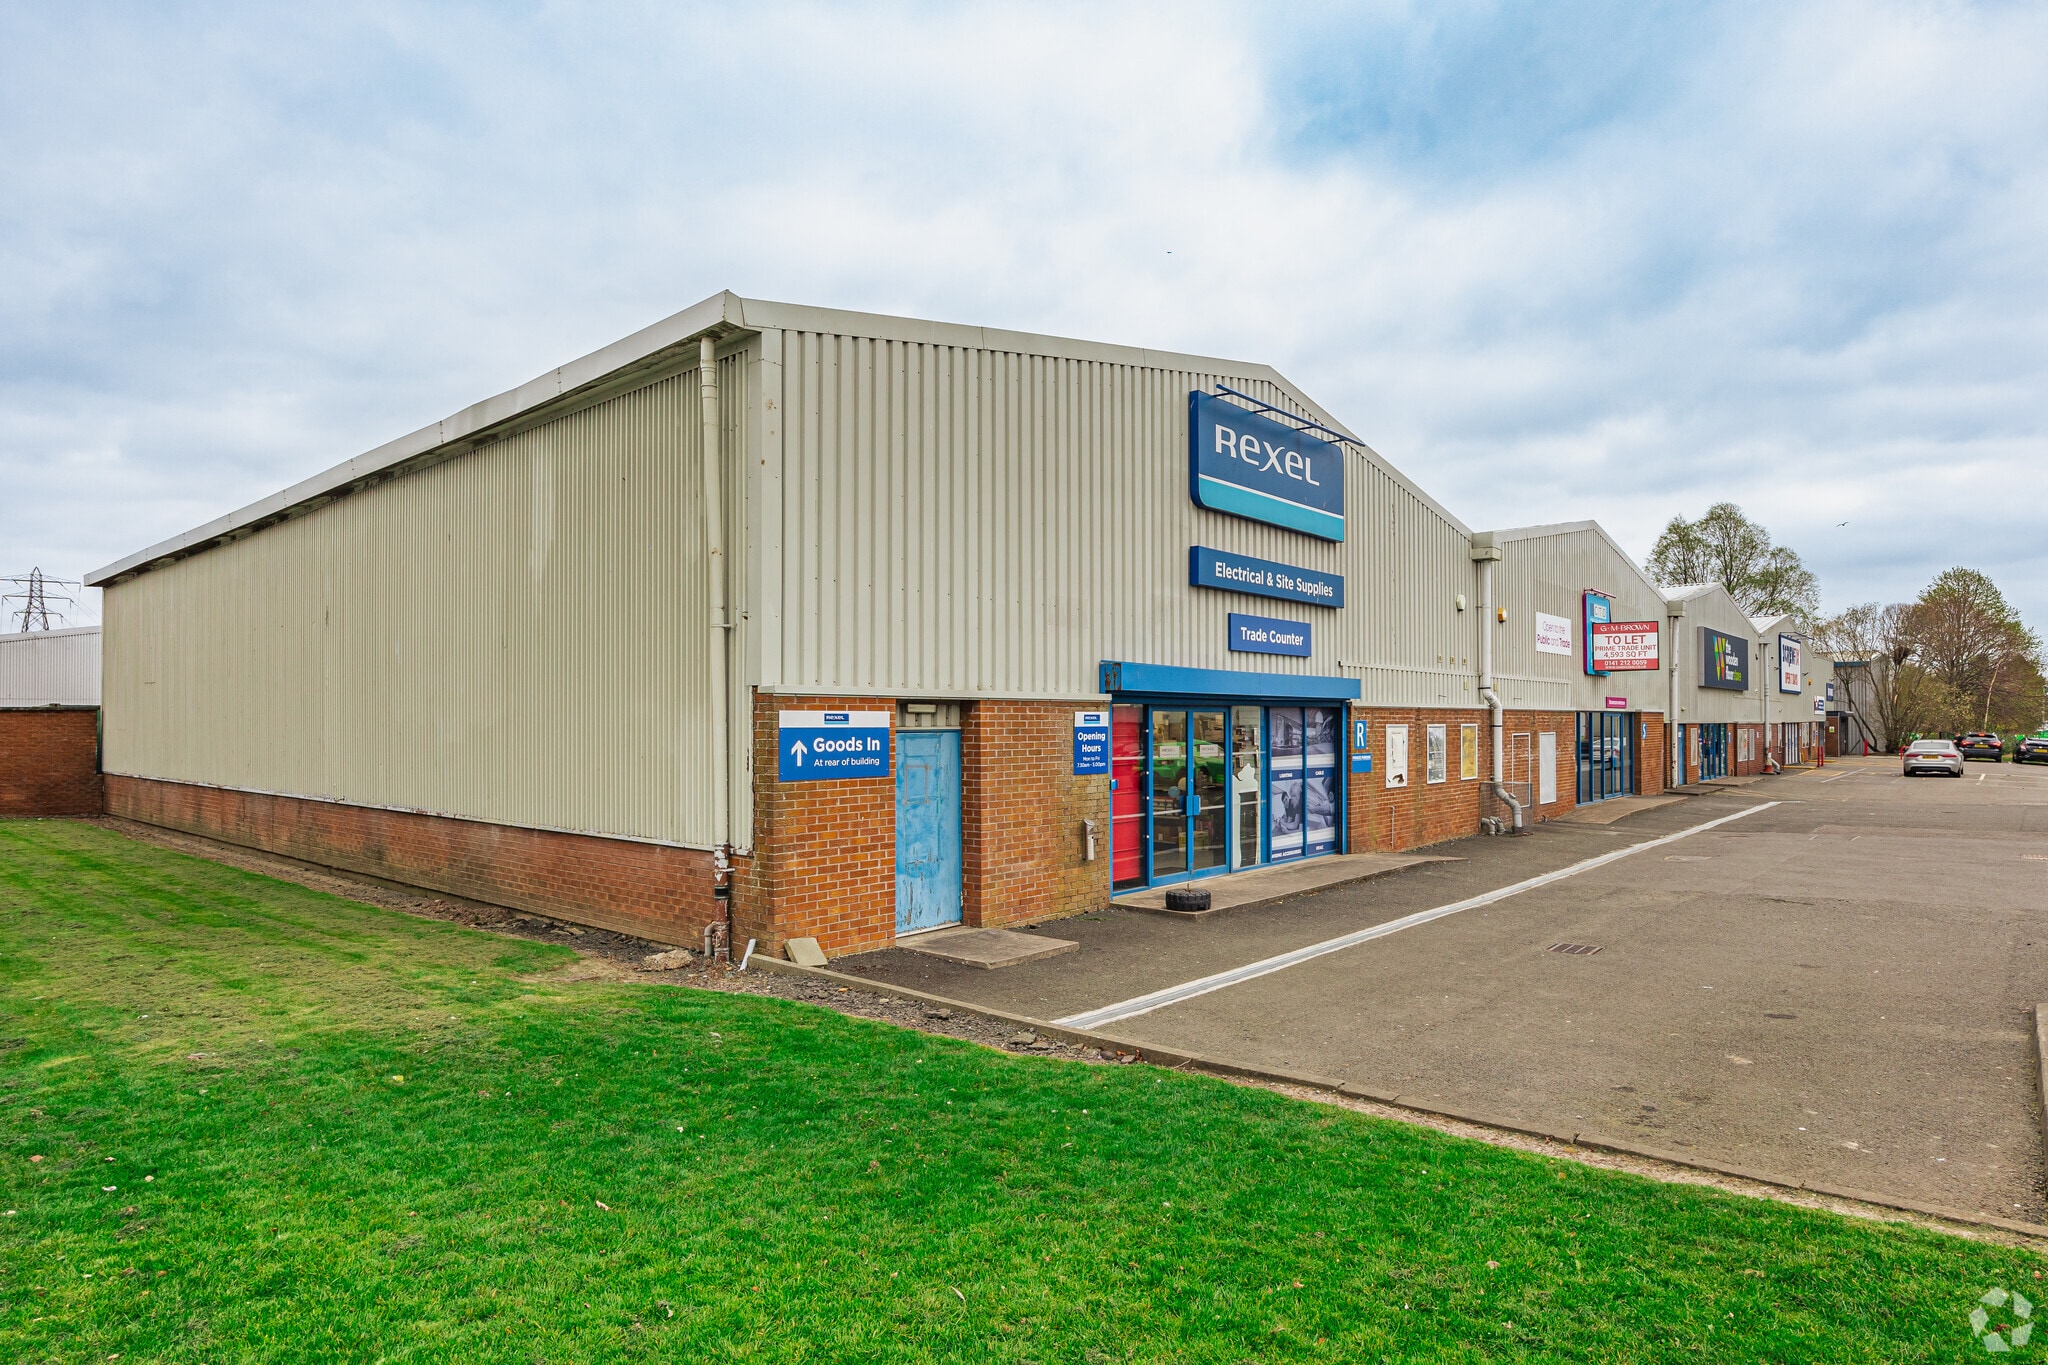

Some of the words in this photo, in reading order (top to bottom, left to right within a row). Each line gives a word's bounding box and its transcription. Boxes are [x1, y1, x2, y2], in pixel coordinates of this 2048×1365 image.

[1215, 561, 1264, 585] Electrical
[1266, 572, 1274, 587] &
[1276, 574, 1294, 590] Site
[1296, 577, 1333, 597] Supplies
[1240, 626, 1267, 643] Trade
[1269, 630, 1304, 646] Counter
[1537, 634, 1551, 646] Public
[1605, 636, 1621, 645] TO
[1624, 635, 1646, 645] LET
[1077, 731, 1106, 742] Opening
[1356, 722, 1365, 747] R
[813, 737, 863, 752] Goods
[867, 737, 880, 751] In
[1082, 744, 1101, 752] Hours
[813, 759, 823, 767] At
[825, 759, 839, 767] rear
[841, 757, 850, 766] of
[851, 757, 880, 766] building
